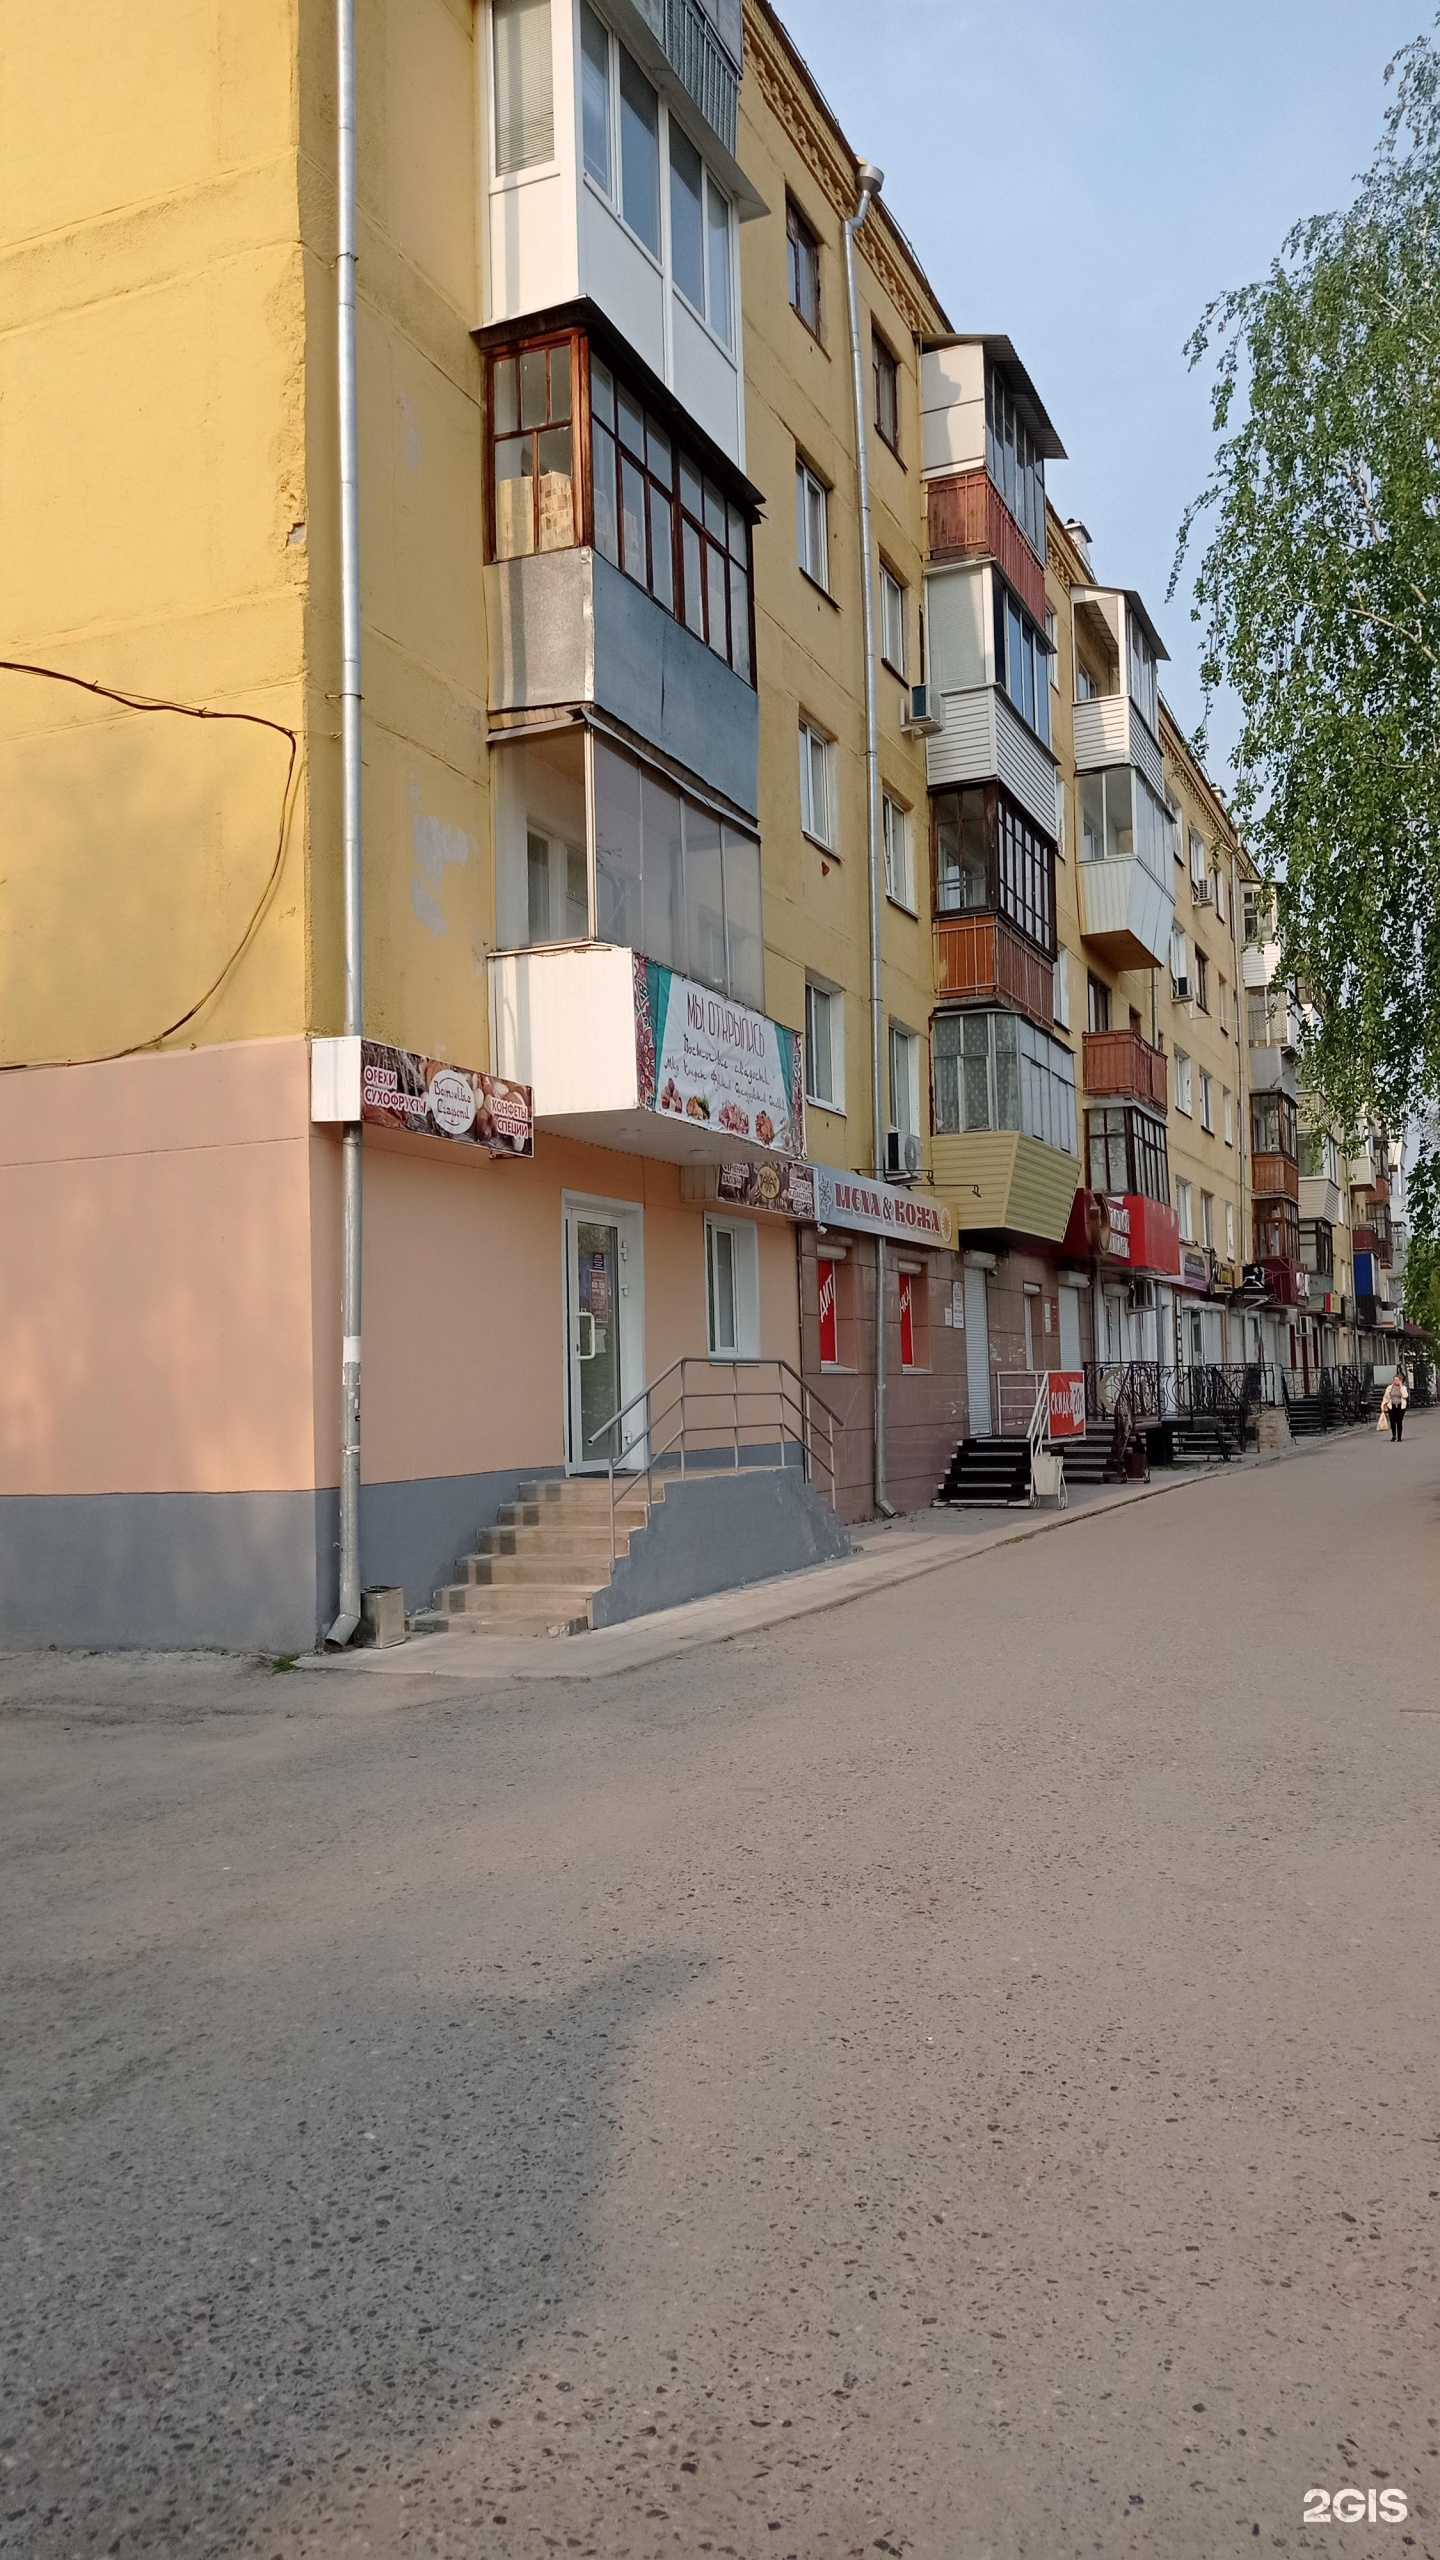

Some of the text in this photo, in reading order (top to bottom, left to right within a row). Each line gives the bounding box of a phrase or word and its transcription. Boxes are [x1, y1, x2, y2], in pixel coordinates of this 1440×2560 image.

[687, 991, 765, 1058] МЫ ОТКРЫЛИСЬ
[365, 1066, 397, 1087] ОРЕХИ
[365, 1087, 427, 1115] СУХОФРУКТЫ
[491, 1098, 528, 1119] КОНФЕТЫ
[497, 1119, 529, 1137] СПЕЦИИ
[834, 1182, 881, 1217] МЕХА
[882, 1196, 892, 1220] &
[894, 1199, 940, 1232] КОЖА
